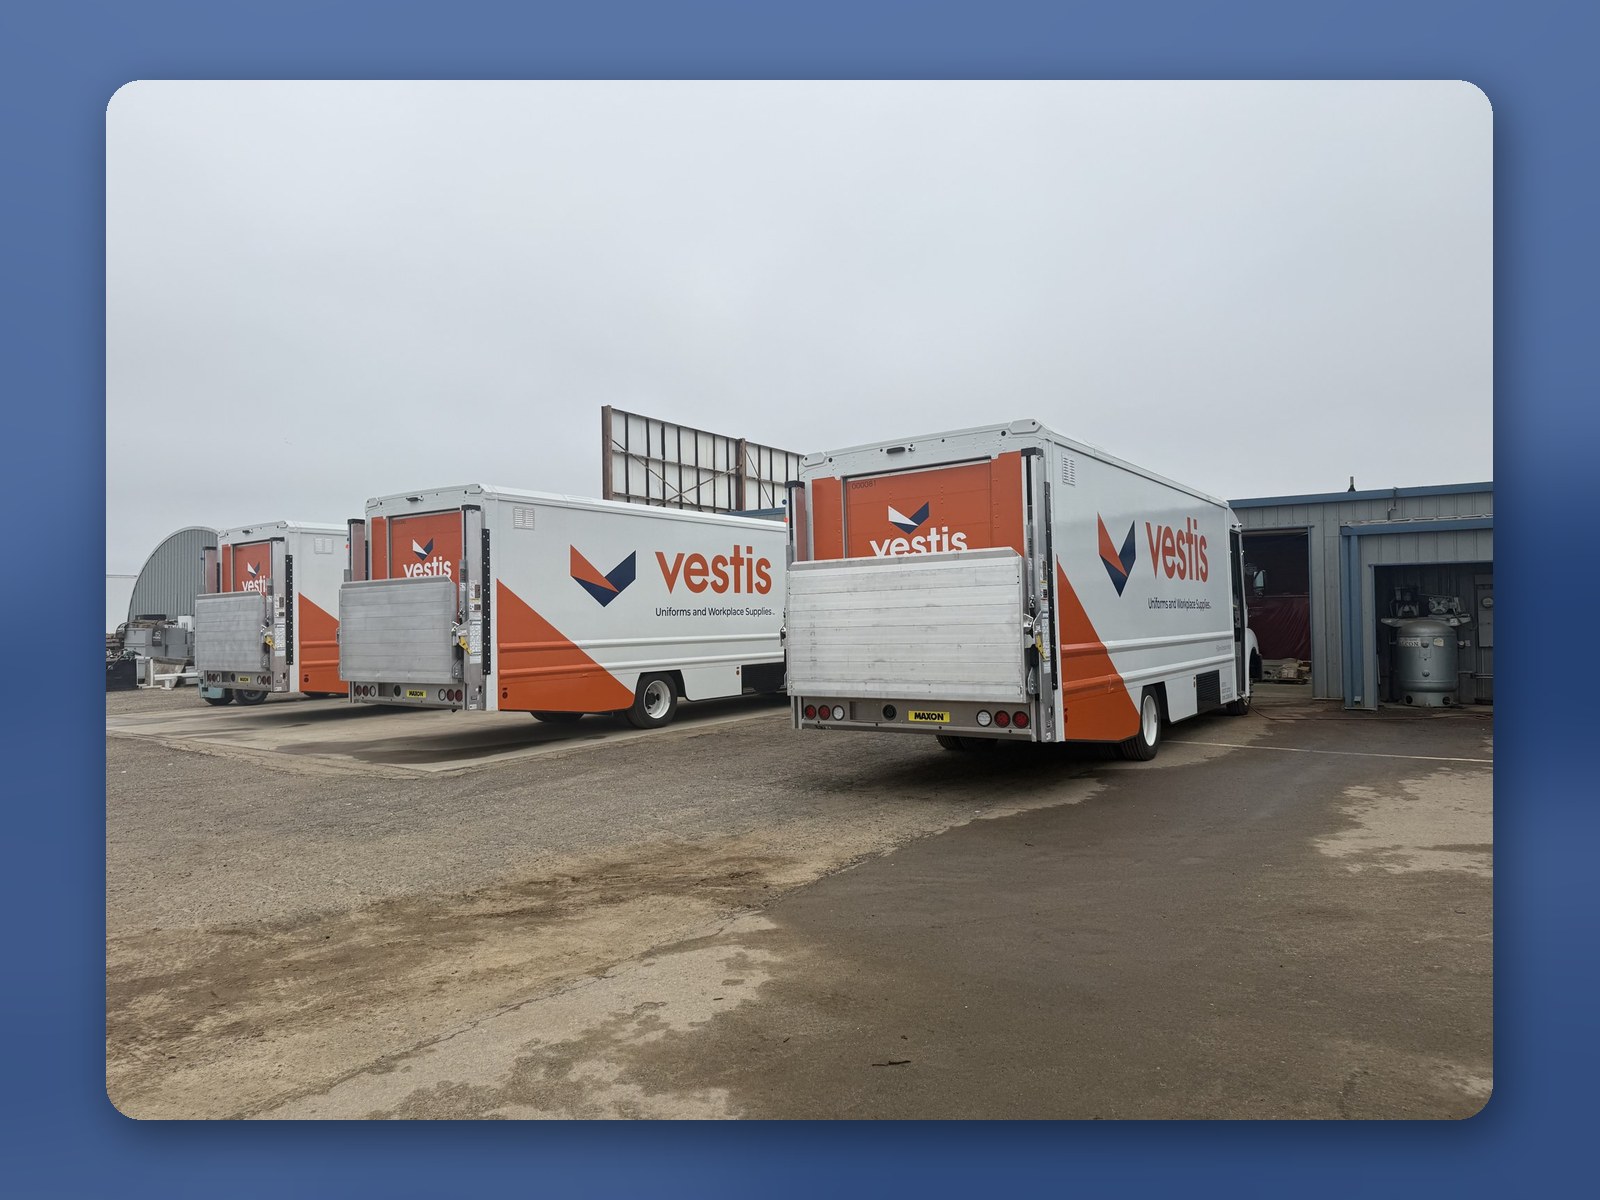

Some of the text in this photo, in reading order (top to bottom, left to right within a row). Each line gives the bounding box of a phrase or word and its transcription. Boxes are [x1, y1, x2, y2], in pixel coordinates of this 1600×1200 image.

[869, 526, 968, 557] vestis
[1145, 516, 1209, 583] vestis
[402, 555, 453, 579] vestis
[654, 544, 772, 595] vestis
[241, 575, 267, 593] vesti
[655, 606, 692, 617] Uniforms
[692, 607, 707, 617] and
[707, 607, 745, 618] Workplace
[1147, 596, 1168, 609] Uniforms
[914, 712, 945, 721] MAXON
